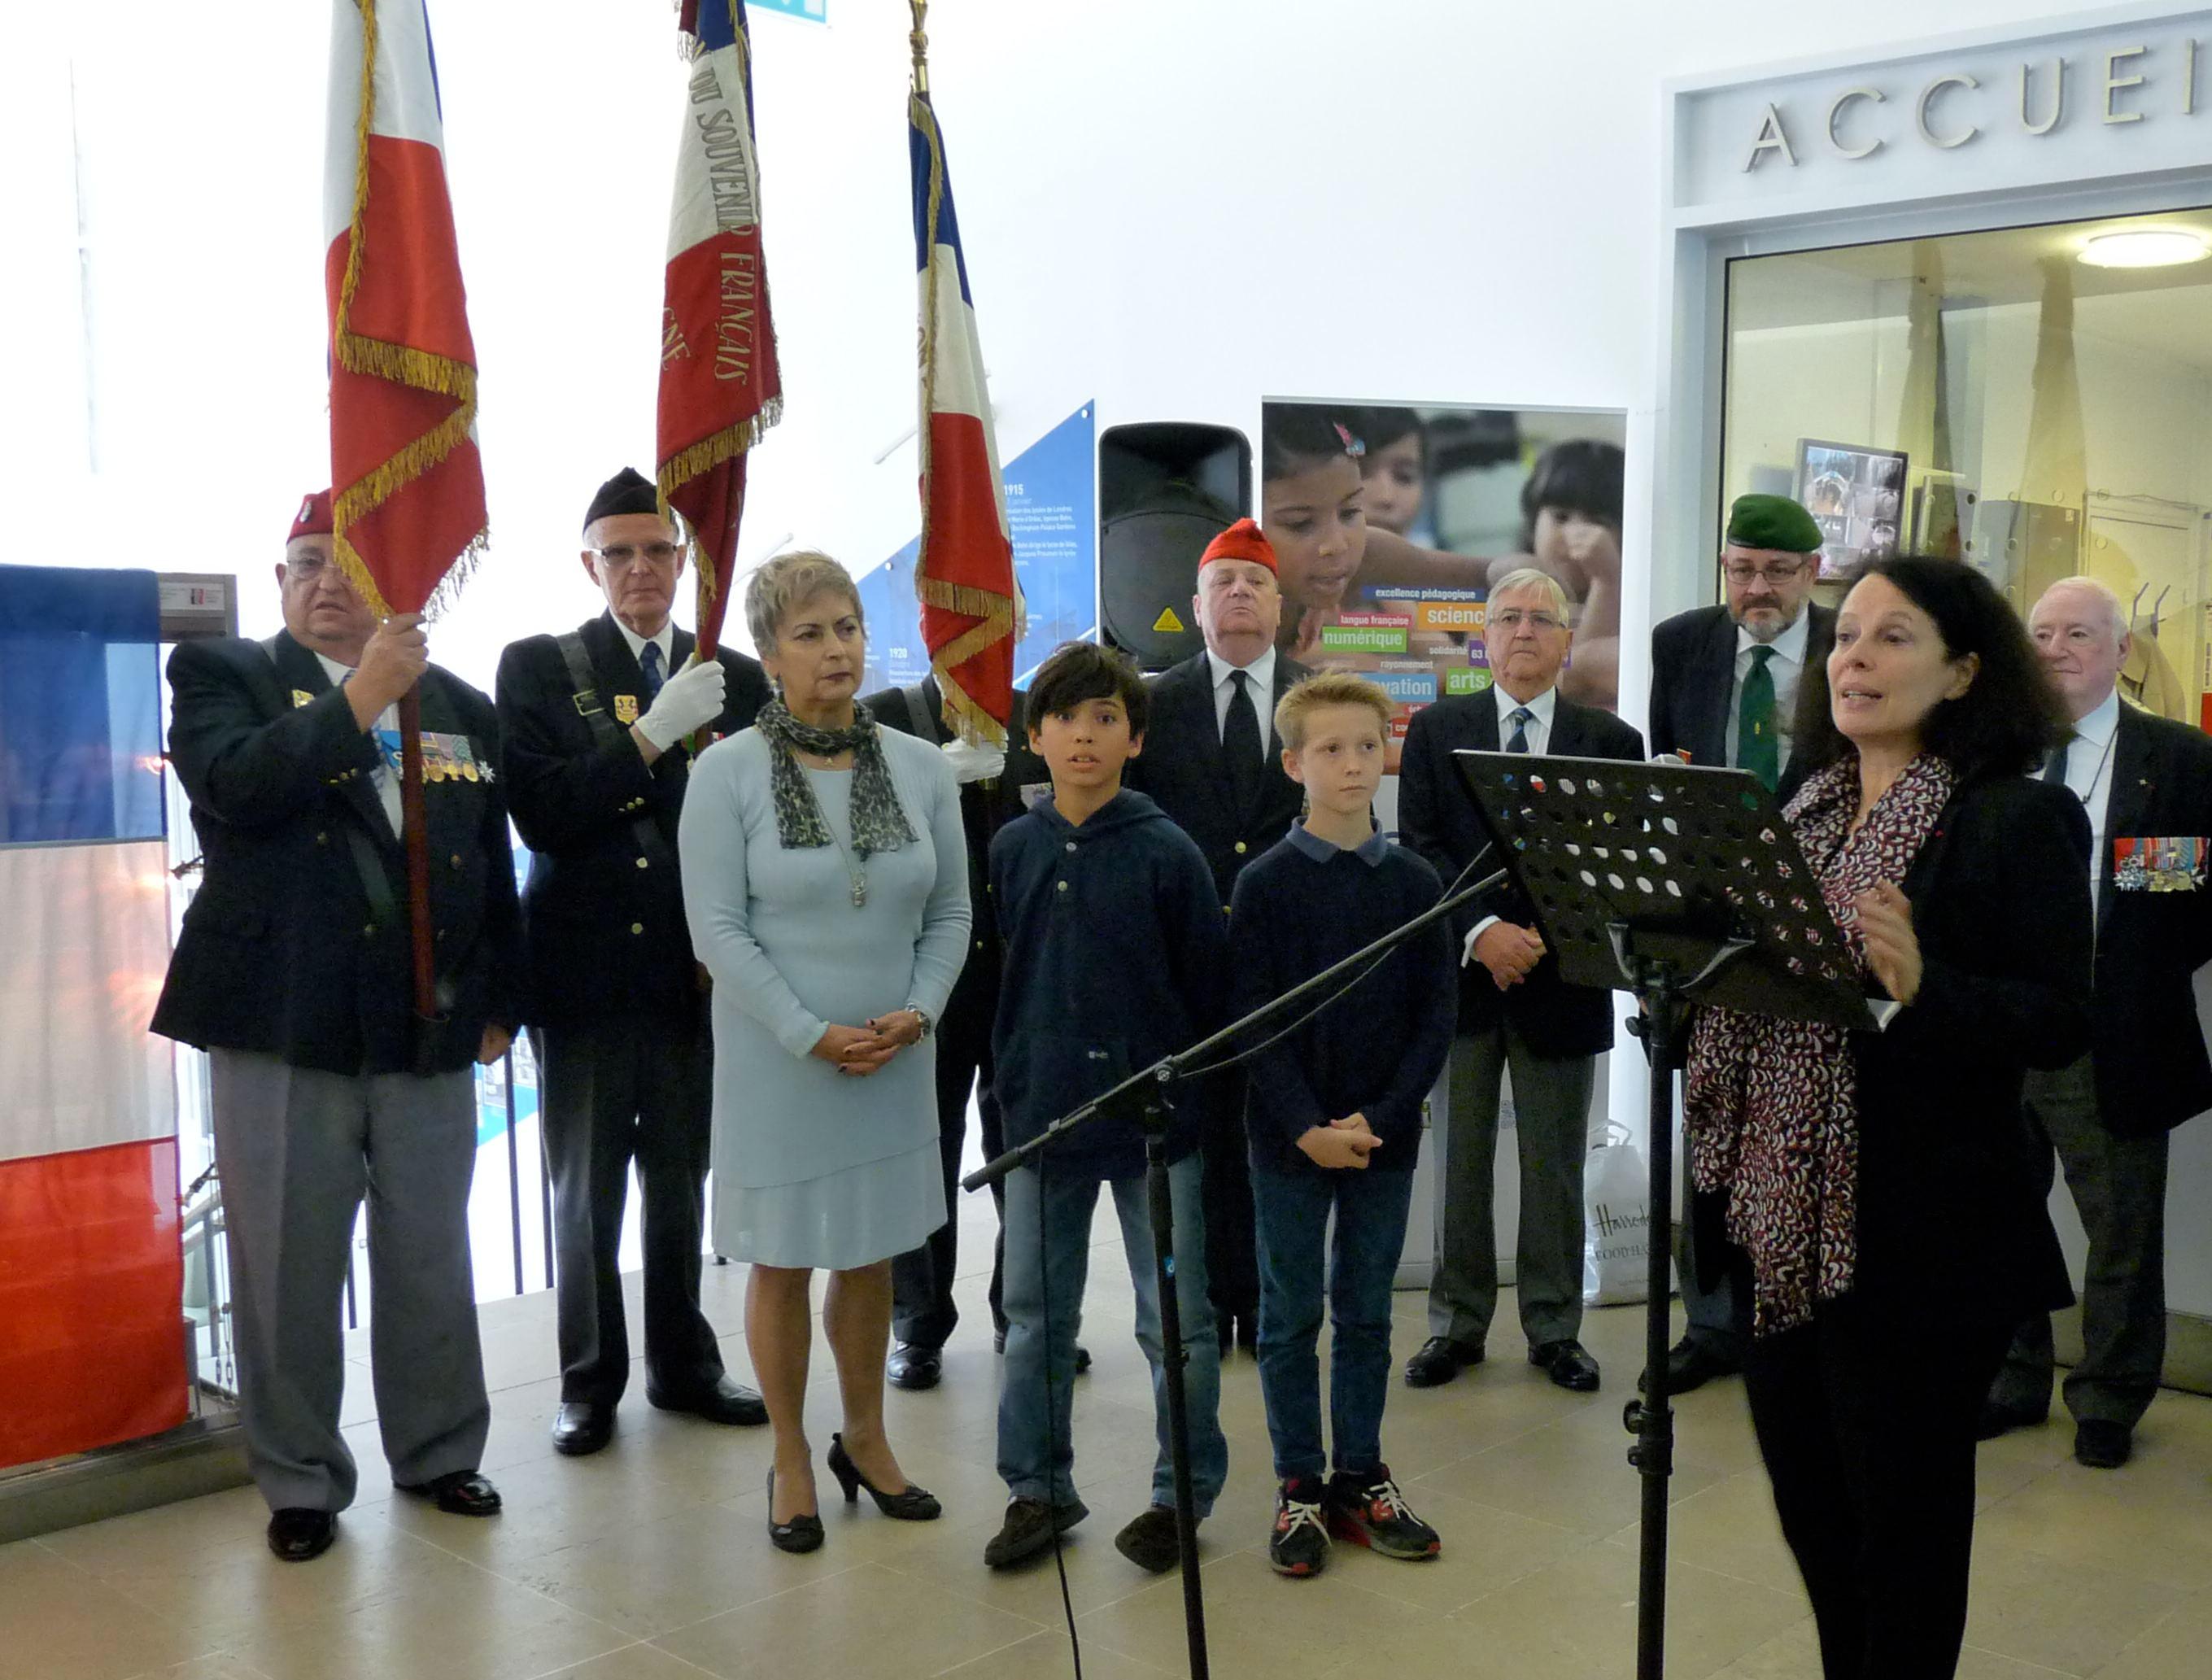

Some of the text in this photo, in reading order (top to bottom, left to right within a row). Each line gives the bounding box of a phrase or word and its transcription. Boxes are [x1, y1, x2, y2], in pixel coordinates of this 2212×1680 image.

[1742, 38, 2198, 173] ACCUEI
[688, 67, 755, 386] DU SOUVENIR FRANÇAIS
[1004, 483, 1024, 495] 1915
[1375, 587, 1476, 600] excellence pédagogique
[1340, 615, 1409, 626] langue française
[1427, 606, 1486, 624] scienc
[1324, 630, 1403, 648] numérique
[1471, 649, 1483, 659] 63
[1380, 678, 1432, 696] vation
[1450, 672, 1486, 689] arts
[1595, 1246, 1630, 1262] FOOD
